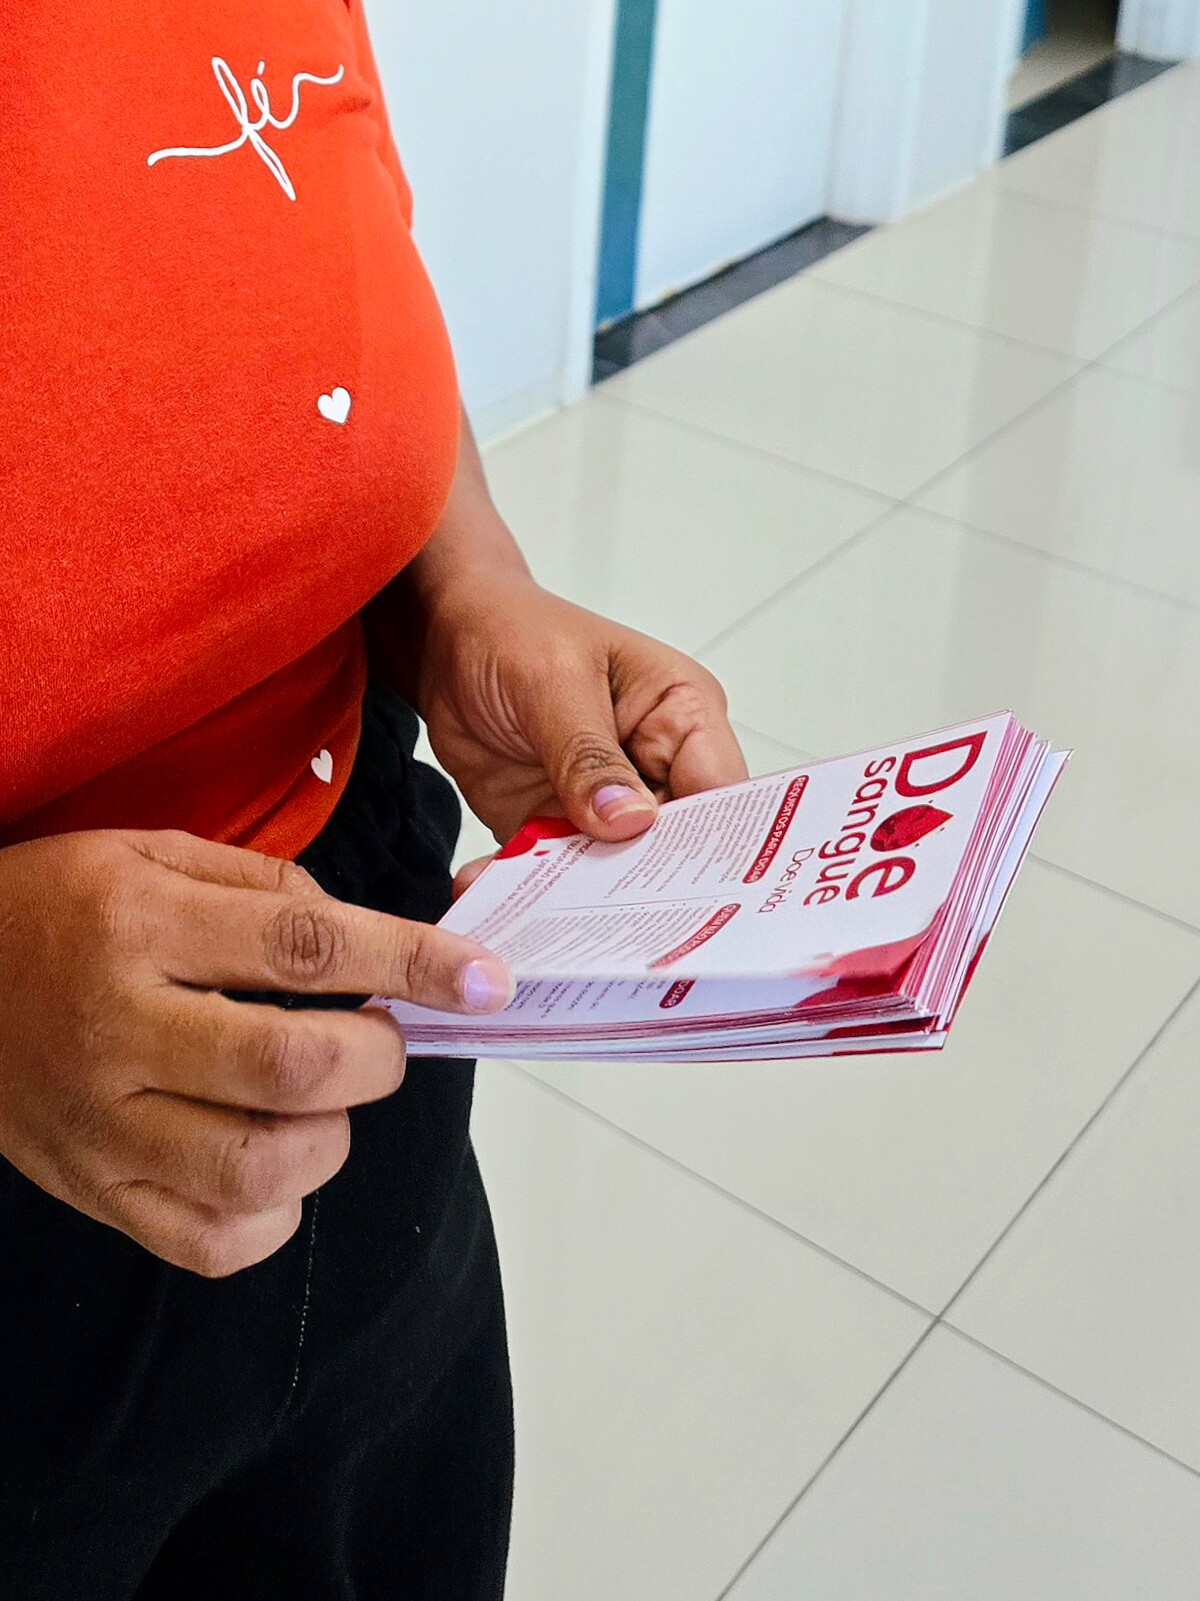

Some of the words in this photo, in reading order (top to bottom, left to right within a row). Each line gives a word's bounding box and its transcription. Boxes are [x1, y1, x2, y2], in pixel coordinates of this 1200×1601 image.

[776, 776, 806, 830] REQUISITOS
[803, 756, 897, 906] sangue
[780, 847, 815, 882] Doe
[757, 882, 792, 914] vida
